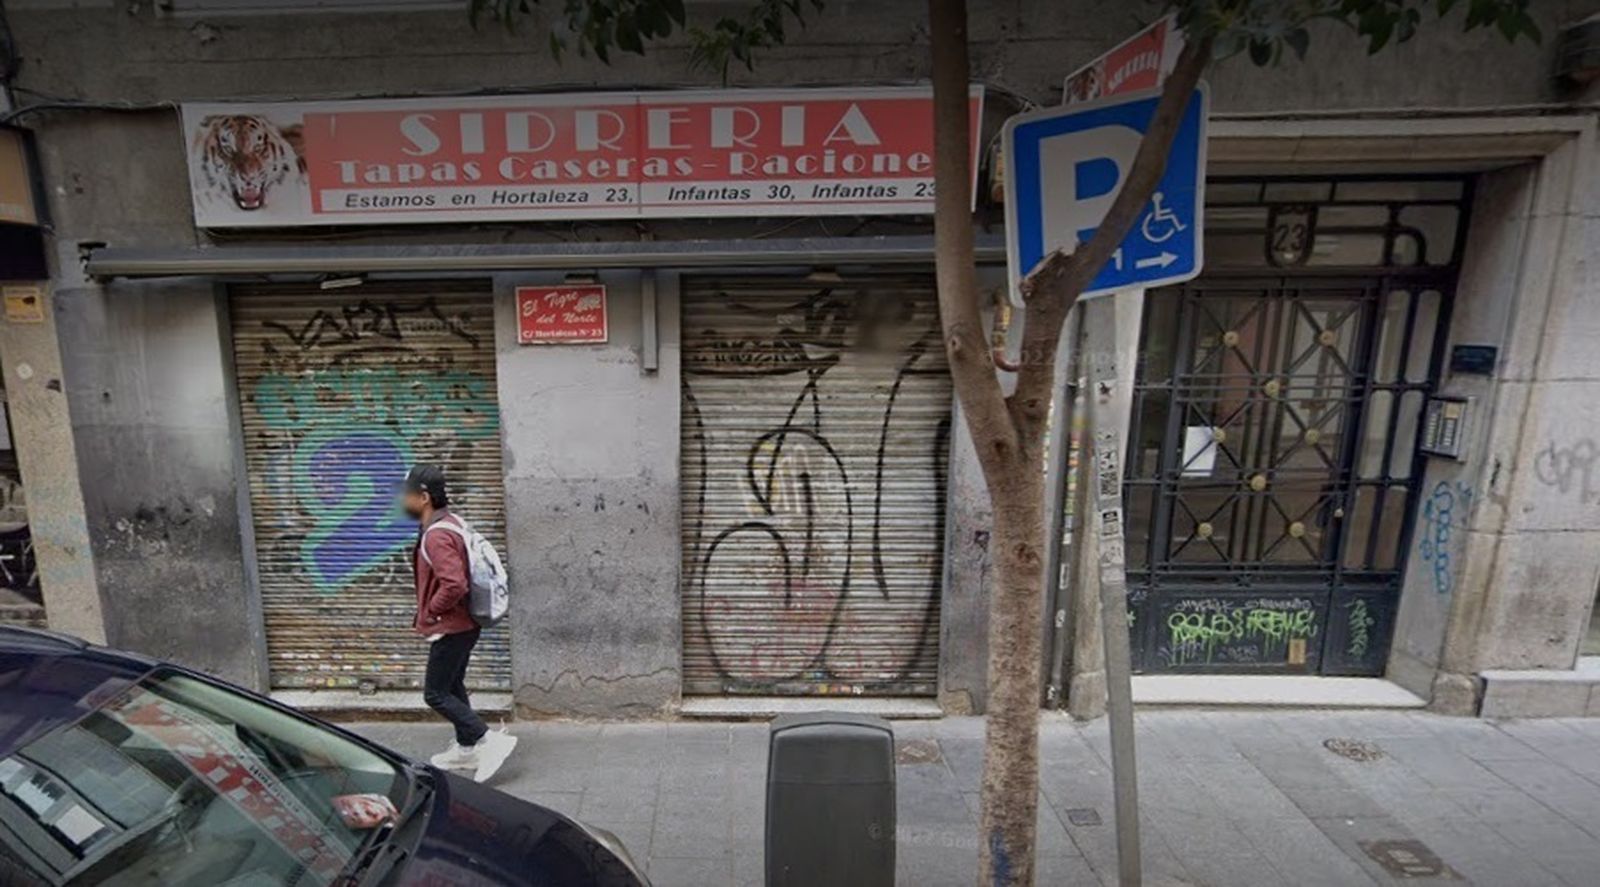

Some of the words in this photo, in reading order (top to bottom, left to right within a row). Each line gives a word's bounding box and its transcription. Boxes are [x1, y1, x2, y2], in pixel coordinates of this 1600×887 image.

[401, 103, 881, 155] SIDRERIA
[333, 158, 481, 184] Tapas
[499, 152, 694, 181] Caseras
[729, 149, 932, 175] Racione
[345, 193, 436, 208] Estamos
[452, 192, 476, 206] en
[492, 188, 589, 205] Hortaleza
[606, 188, 634, 204] 23,
[668, 185, 751, 201] Infantas
[767, 184, 796, 201] 30,
[811, 183, 898, 199] Infantas
[1038, 123, 1146, 256] P
[1275, 224, 1306, 252] 23
[522, 300, 538, 317] El
[544, 290, 578, 308] Tigre
[536, 313, 556, 324] del
